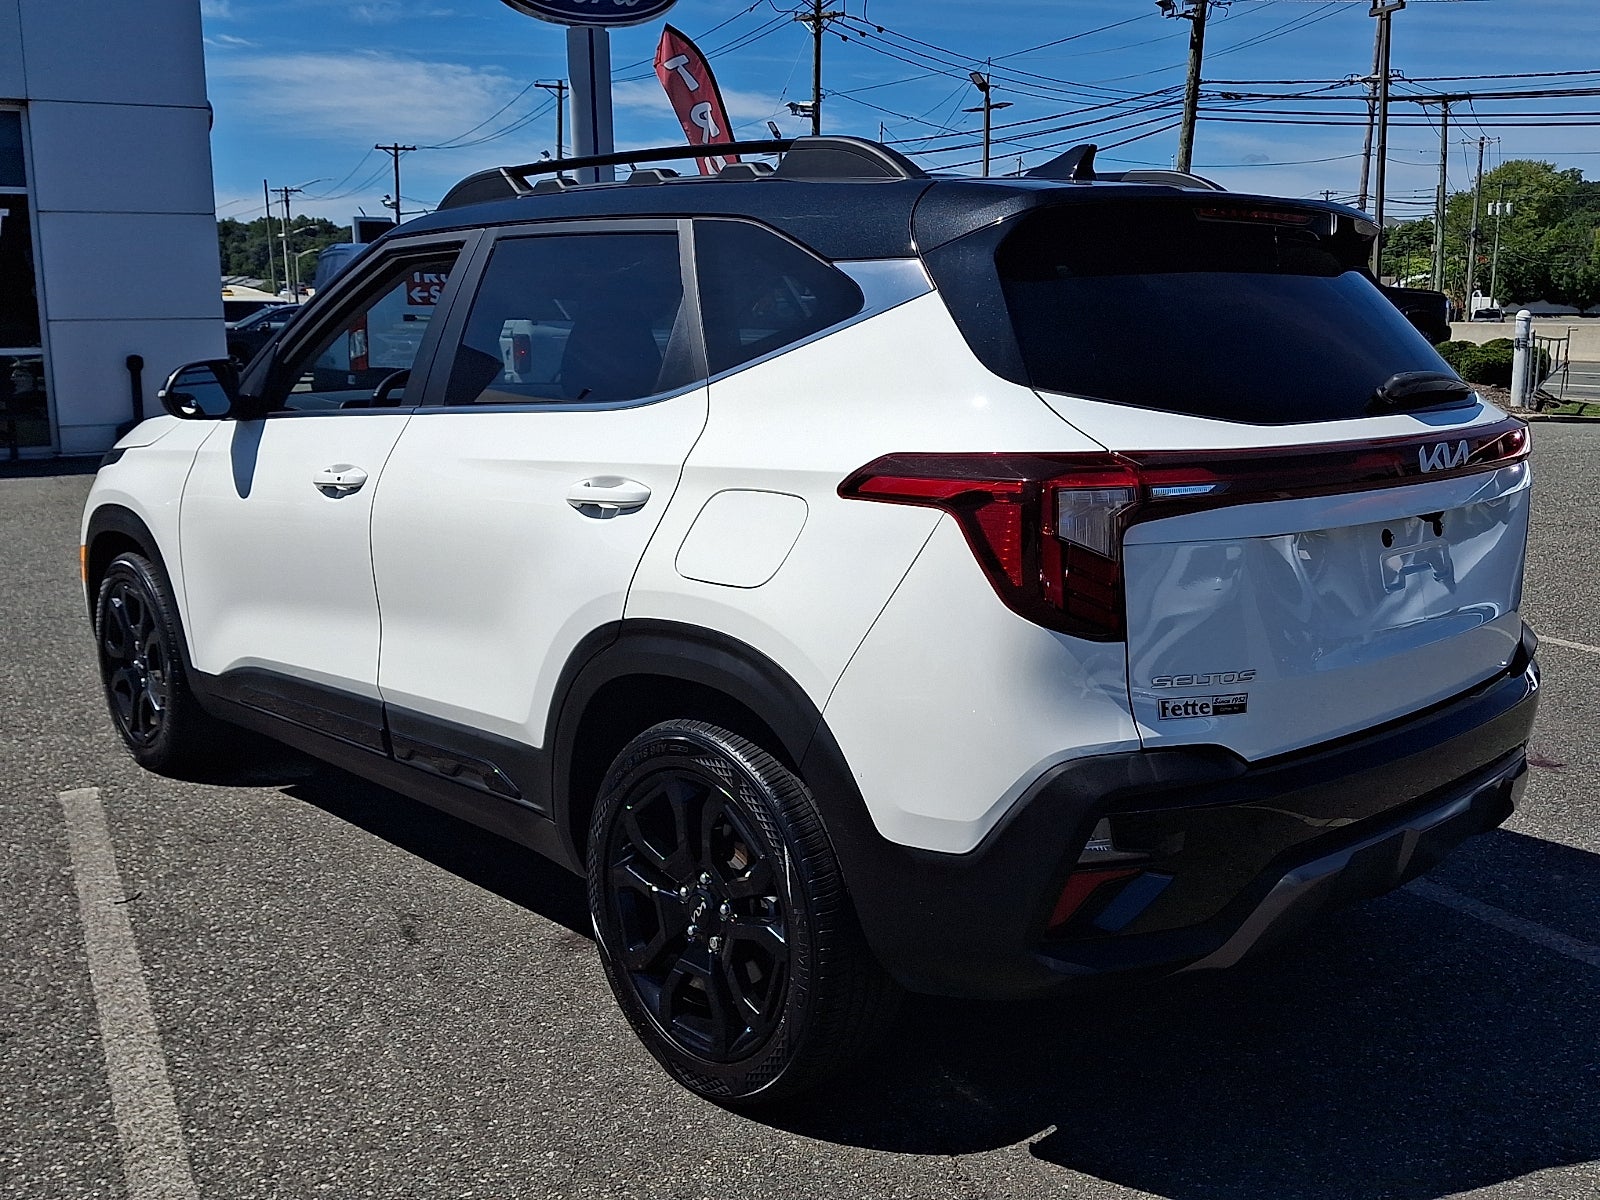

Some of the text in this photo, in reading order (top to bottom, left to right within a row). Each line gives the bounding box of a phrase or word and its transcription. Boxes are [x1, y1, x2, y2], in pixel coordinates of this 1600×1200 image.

[1419, 440, 1470, 473] KIA
[1151, 669, 1256, 689] SELTOS
[1160, 699, 1211, 718] Fette
